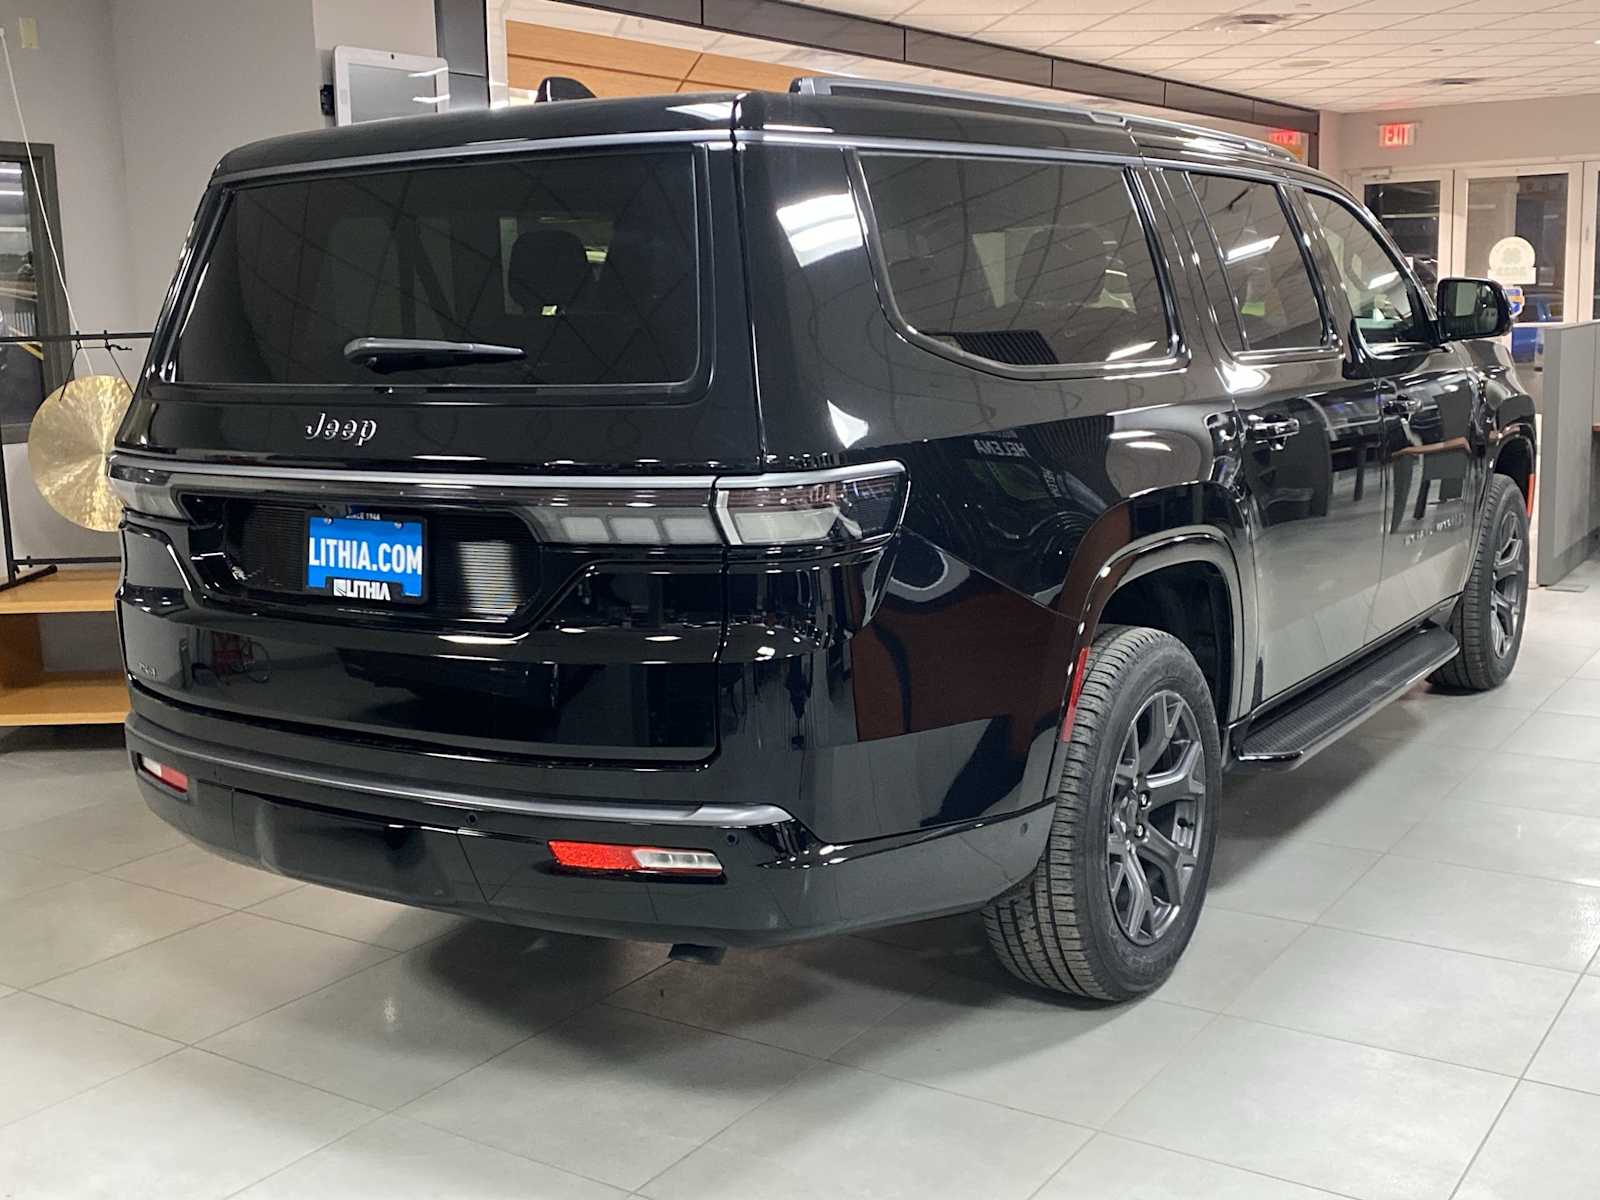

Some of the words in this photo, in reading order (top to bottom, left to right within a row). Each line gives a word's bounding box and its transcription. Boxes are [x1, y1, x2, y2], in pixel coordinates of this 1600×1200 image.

[1384, 123, 1409, 145] EXIT
[304, 412, 378, 446] Jeep
[309, 536, 423, 575] LITHIA.COM
[346, 579, 391, 601] LITHIA
